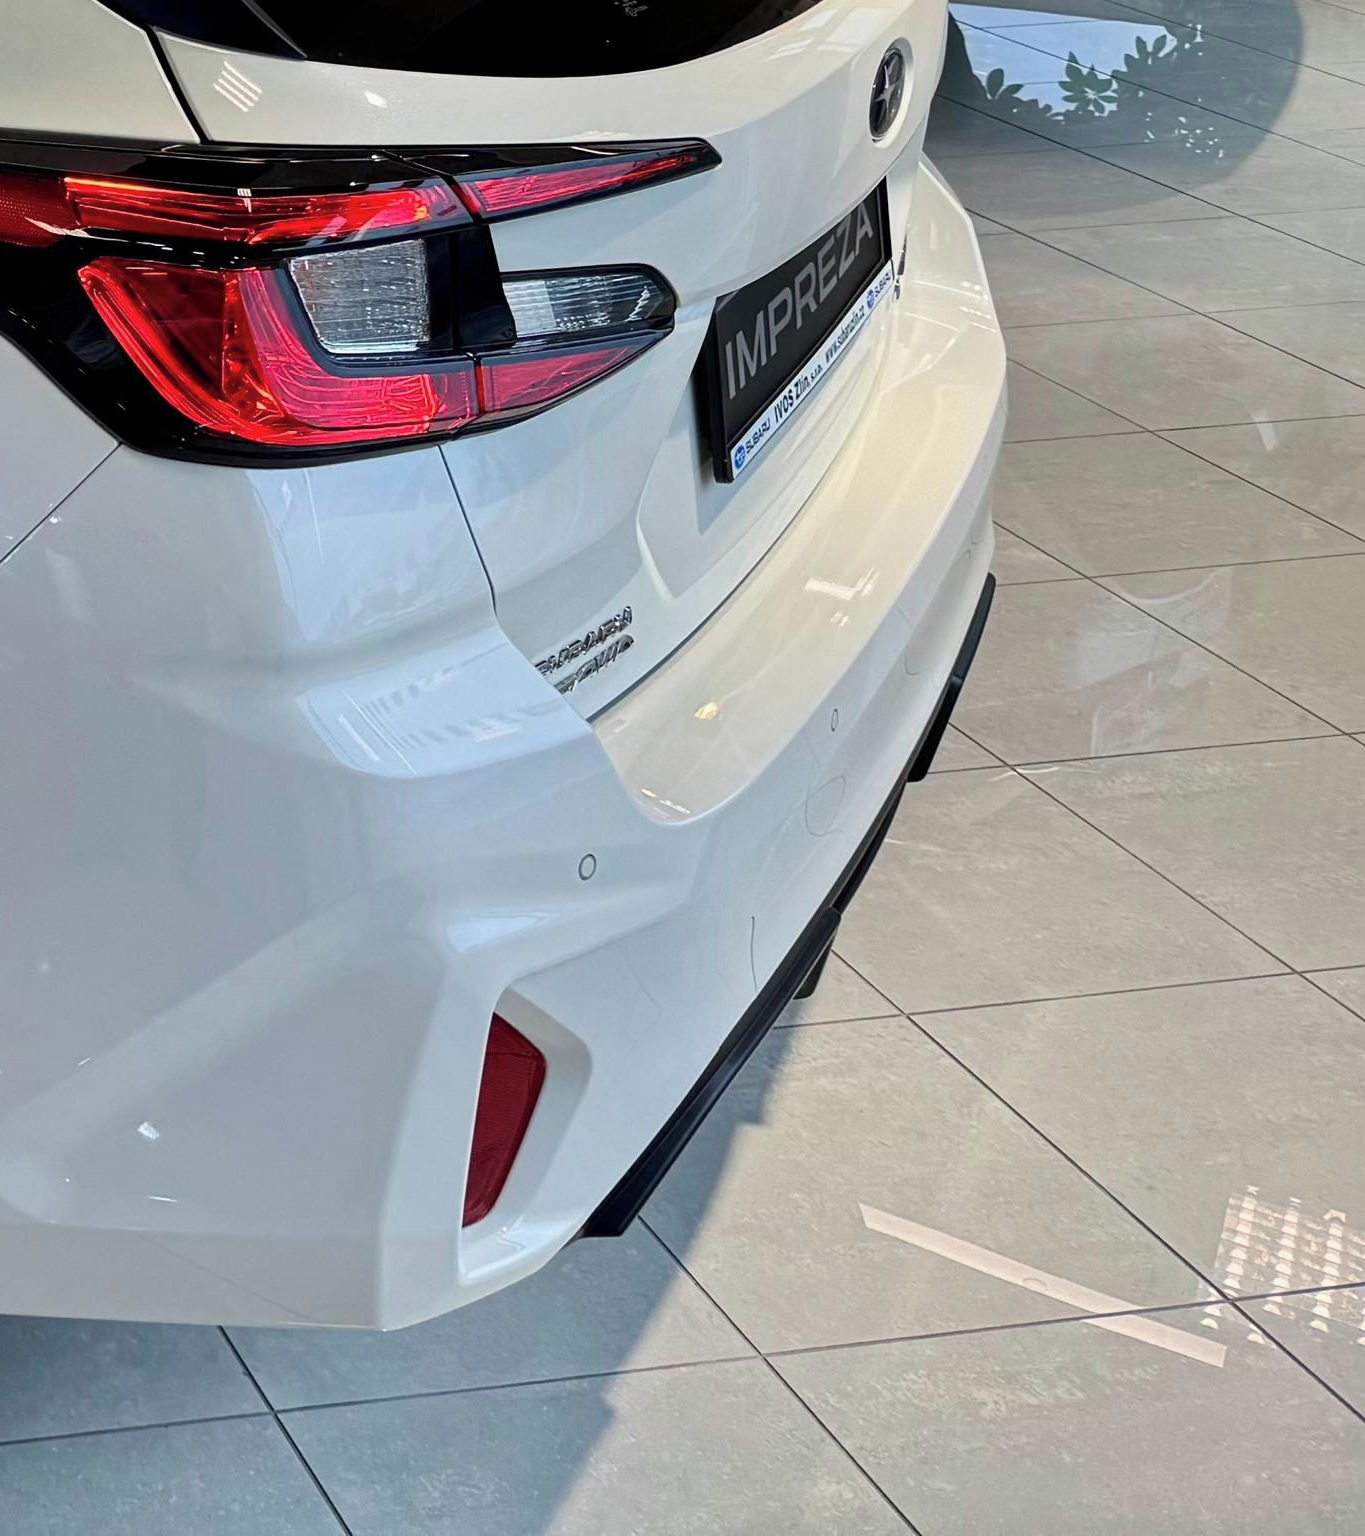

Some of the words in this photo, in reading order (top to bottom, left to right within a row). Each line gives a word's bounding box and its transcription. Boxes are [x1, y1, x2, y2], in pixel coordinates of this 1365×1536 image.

[725, 205, 875, 399] IMPREZA
[746, 417, 771, 454] SUBARU
[774, 389, 794, 423] IVOS
